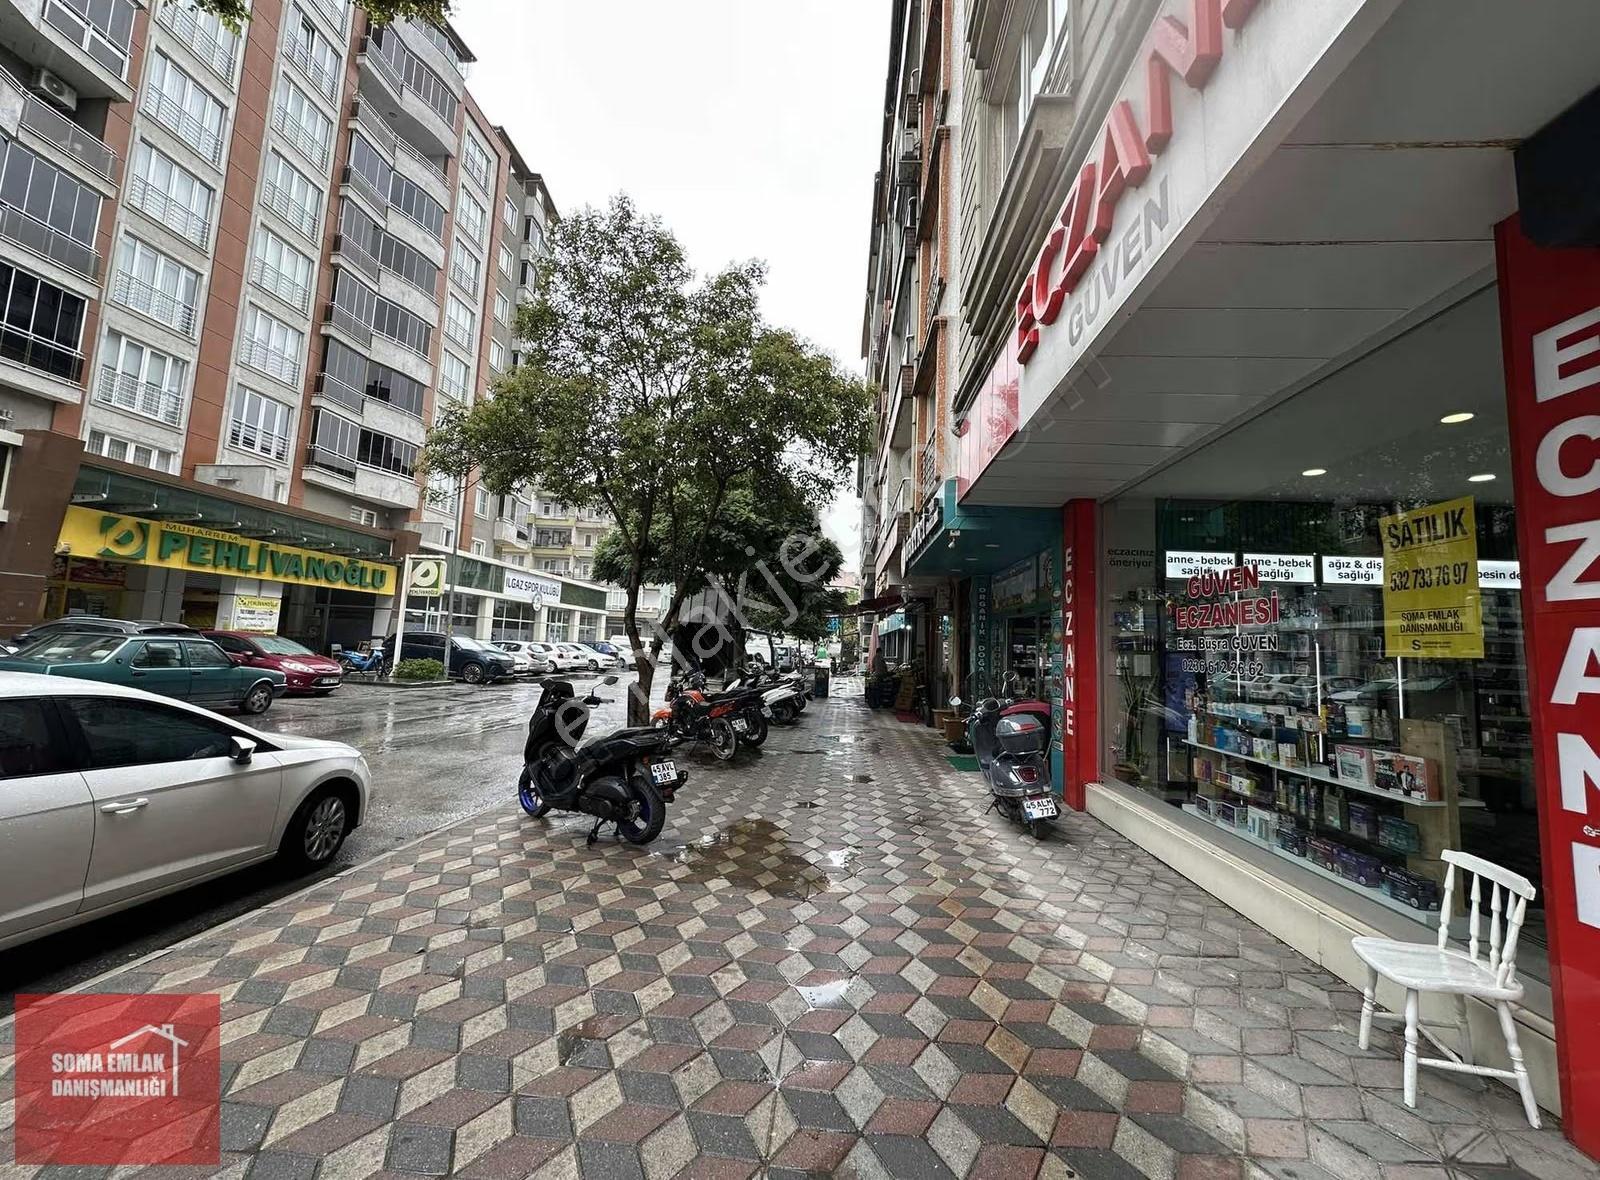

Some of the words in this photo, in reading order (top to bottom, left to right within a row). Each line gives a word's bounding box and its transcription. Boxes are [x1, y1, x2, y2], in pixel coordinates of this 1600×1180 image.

[1017, 0, 1262, 365] ECZAN
[1068, 174, 1170, 348] GÜVEN
[165, 522, 239, 542] MUHARREM
[1388, 507, 1468, 549] SATILIK
[158, 529, 387, 590] PEHLİVANOĞLU
[1328, 560, 1351, 570] ağız
[1354, 560, 1363, 569] &
[1366, 560, 1382, 571] diş
[1187, 563, 1260, 599] GÜVEN
[1258, 569, 1294, 581] sağlığı
[1337, 570, 1374, 582] sağlığı
[1390, 570, 1410, 592] 532
[1412, 566, 1433, 589] 733
[1436, 564, 1450, 588] 76
[1453, 562, 1469, 585] 97
[524, 581, 539, 593] SPOR
[1175, 589, 1279, 630] ECZANESİ
[1401, 611, 1425, 622] SOMA
[1427, 609, 1460, 621] EMLAK
[1400, 622, 1463, 635] DANIŞMANLIĞI
[1064, 547, 1075, 737] ECZANE
[1177, 637, 1197, 651] Ecz.
[1197, 637, 1229, 653] Büşra
[1231, 633, 1278, 651] GÜVEN
[1182, 658, 1206, 673] 0236
[1208, 659, 1228, 674] 612
[1230, 660, 1245, 677] 26
[1248, 661, 1264, 677] 62
[1040, 807, 1056, 816] 772
